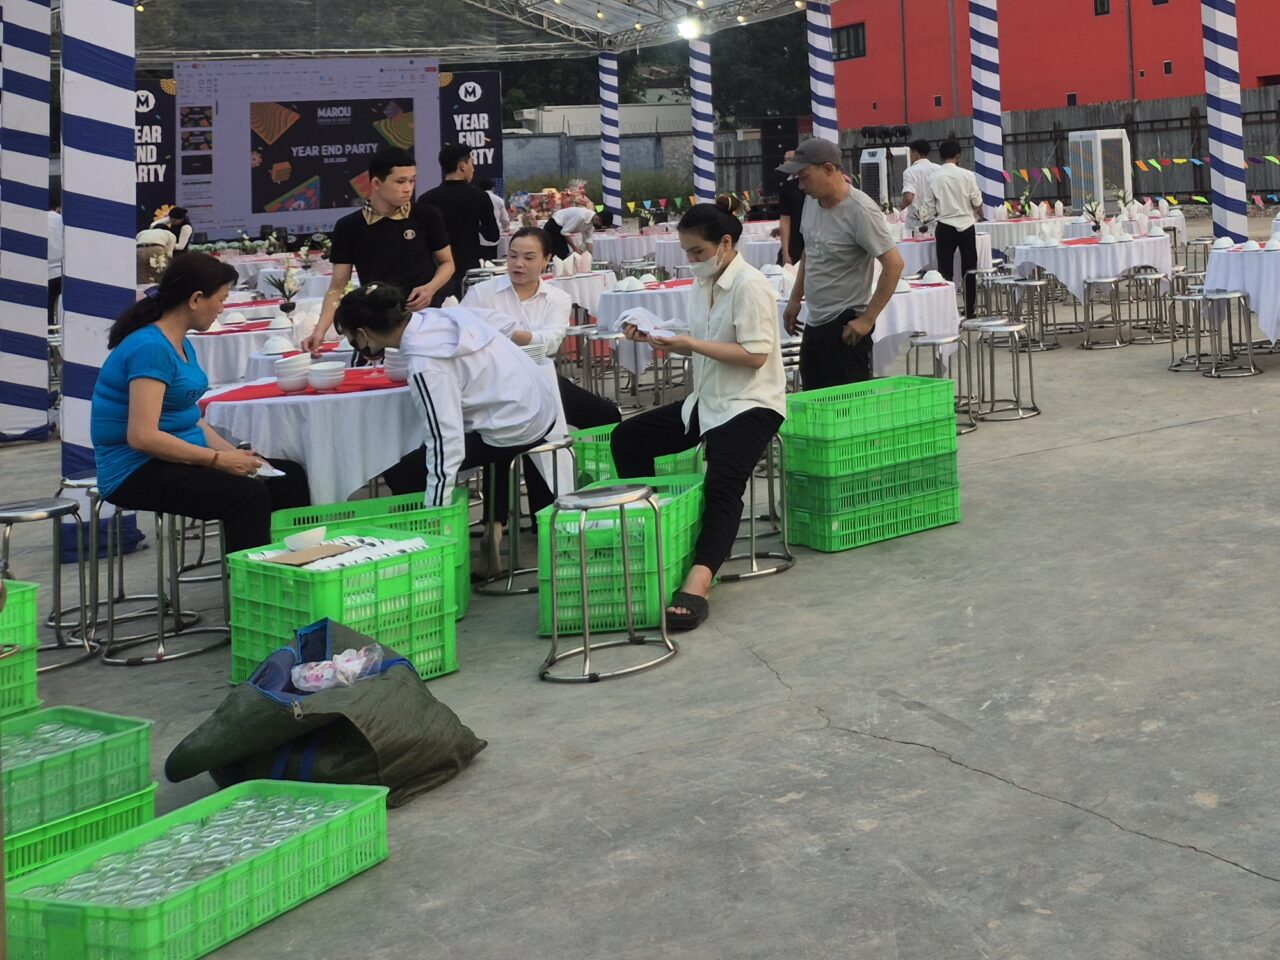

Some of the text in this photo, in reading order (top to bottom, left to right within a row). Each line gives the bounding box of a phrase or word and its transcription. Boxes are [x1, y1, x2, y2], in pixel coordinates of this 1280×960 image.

[317, 106, 353, 118] MAROU
[453, 113, 489, 131] YEAR
[135, 125, 162, 143] EAR
[136, 145, 157, 163] ND
[291, 143, 378, 157] YEAR END PARTY
[137, 164, 167, 183] RTY
